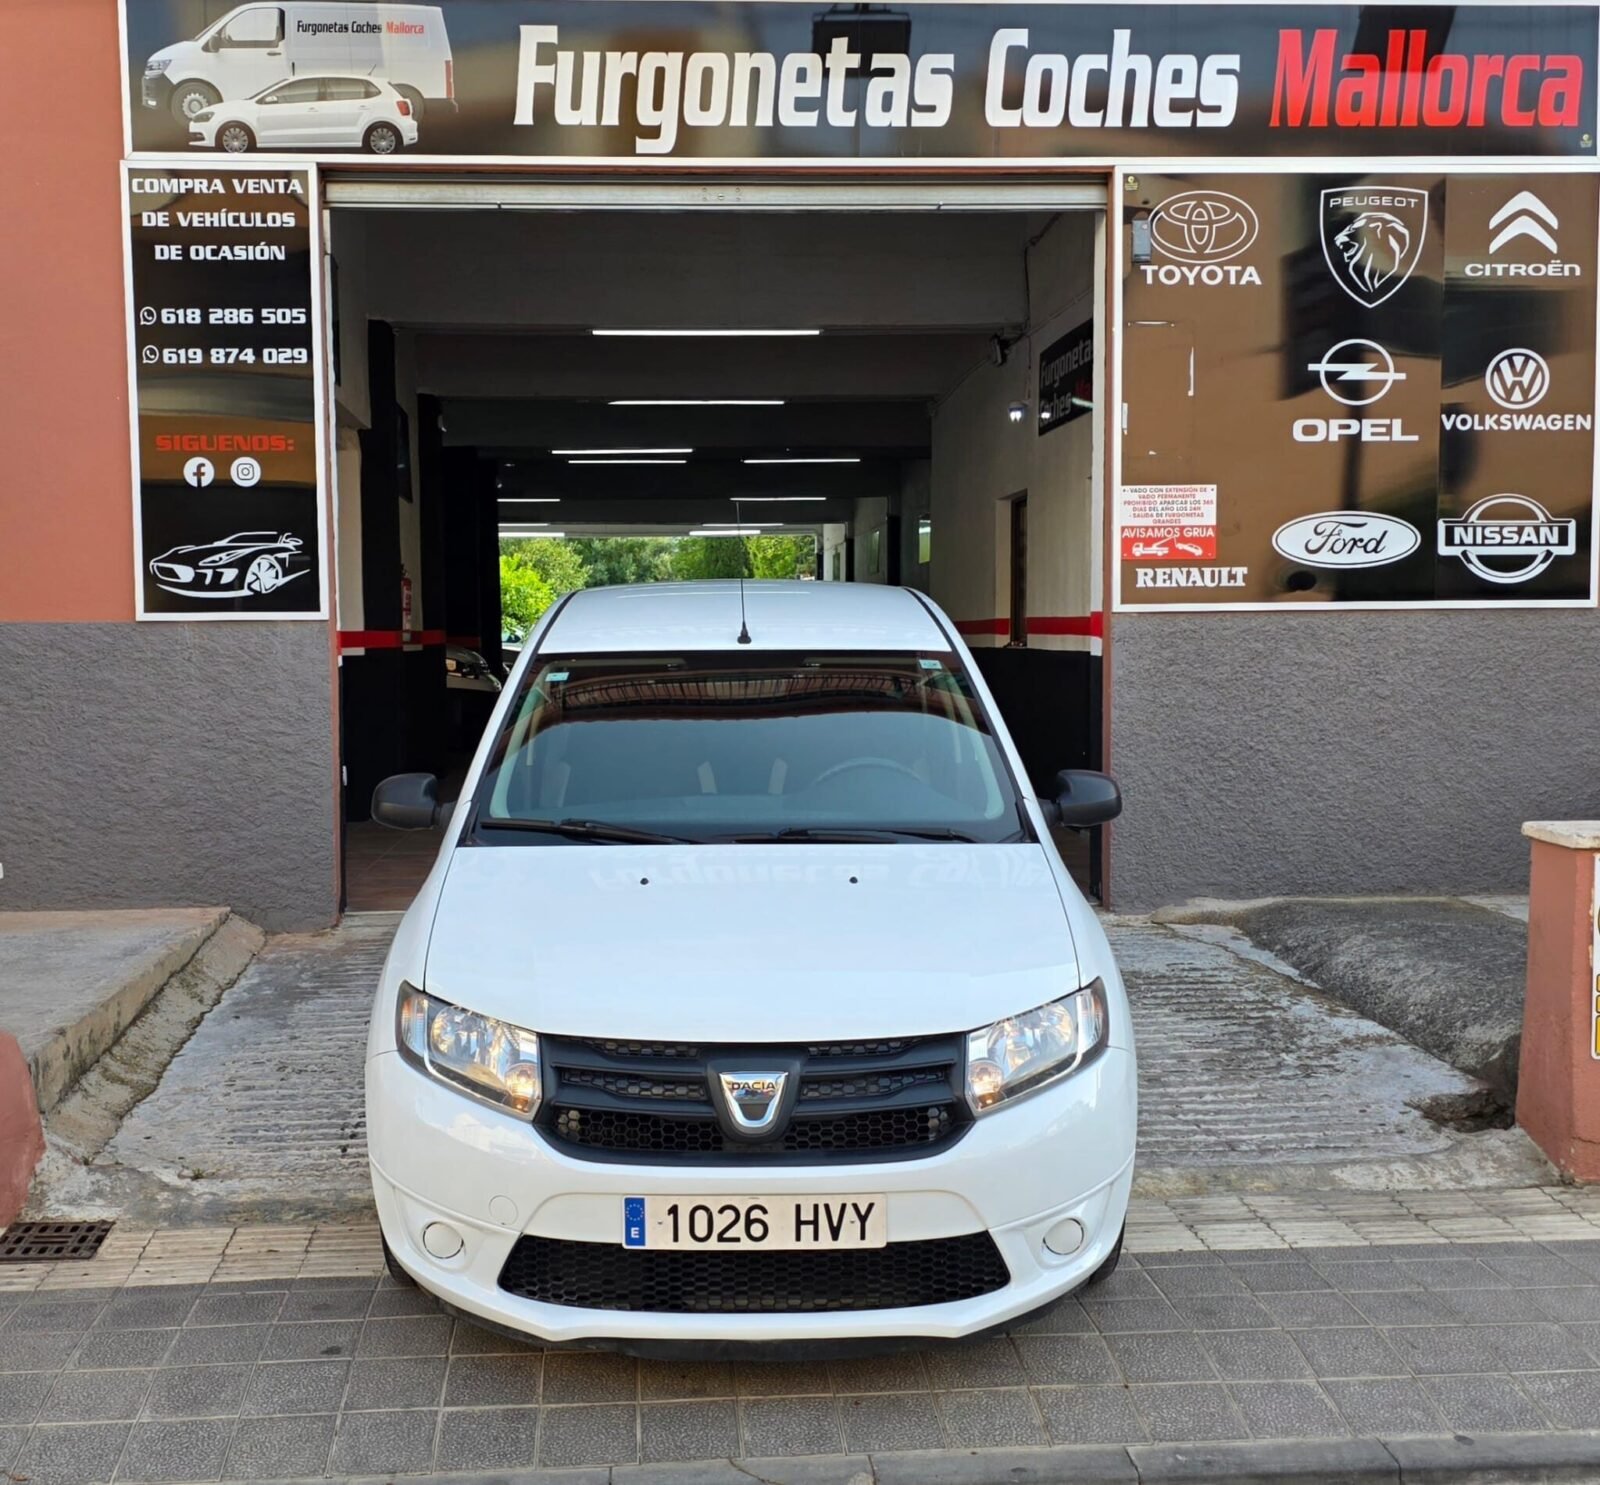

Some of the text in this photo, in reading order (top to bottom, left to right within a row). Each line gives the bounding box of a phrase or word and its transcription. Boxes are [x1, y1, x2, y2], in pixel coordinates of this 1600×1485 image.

[297, 20, 425, 36] Furgonetas Coches Mallorca
[513, 25, 1583, 154] Furgonetas Coches Mallorca
[132, 178, 304, 194] COMPRA VENTA
[1329, 197, 1419, 208] PEUGEOT
[142, 208, 296, 228] DE VEHÍCULOS
[154, 242, 286, 261] DE OCASIÓN
[1140, 265, 1262, 286] TOYOTA
[161, 308, 307, 324] 618 286 505
[162, 348, 308, 364] 619 874 029
[1040, 339, 1092, 389] Furgoneta
[1292, 418, 1419, 442] OPEL
[1441, 414, 1592, 431] VOLKSWAGEN
[155, 434, 295, 451] SIGUENOS:
[1122, 527, 1215, 538] AVISAMOS GRUA
[1304, 521, 1389, 554] Ford
[1453, 526, 1559, 544] NISSAN
[1136, 567, 1248, 588] RENAULT
[731, 1081, 776, 1091] DACIA
[667, 1202, 875, 1242] 1026 HVY
[631, 1226, 640, 1239] E
